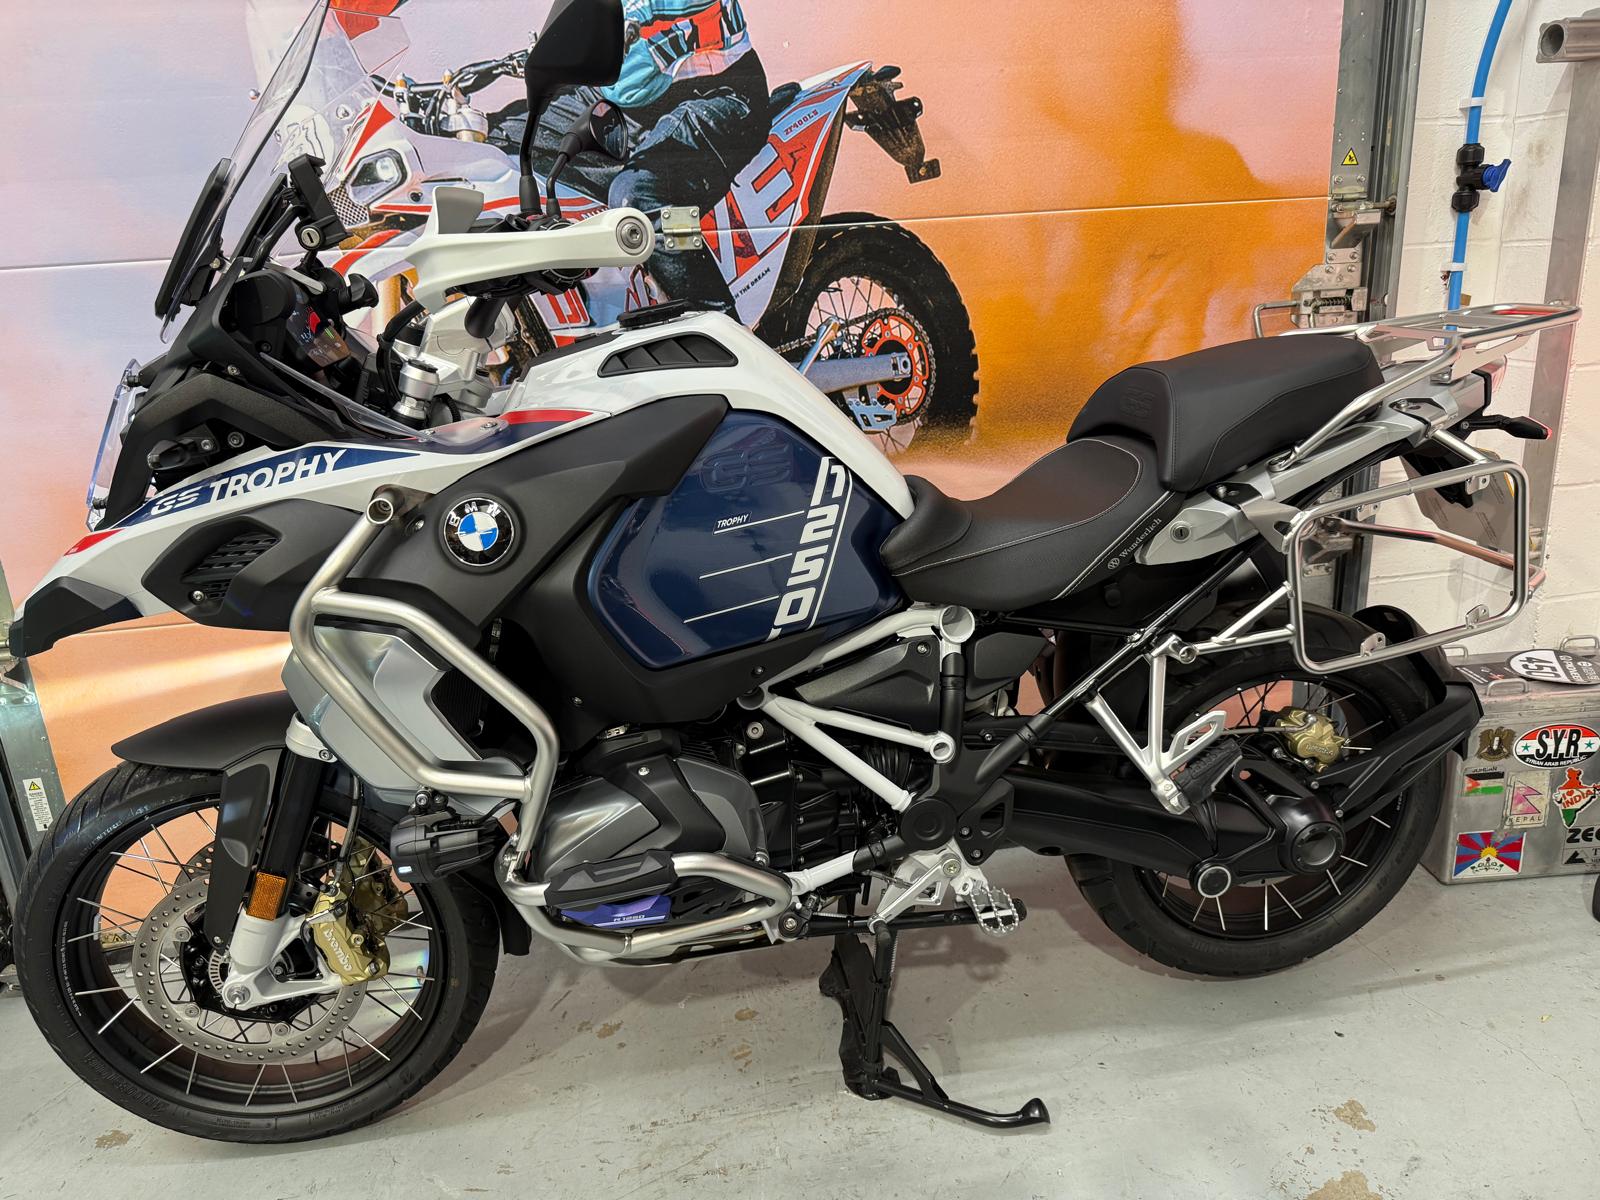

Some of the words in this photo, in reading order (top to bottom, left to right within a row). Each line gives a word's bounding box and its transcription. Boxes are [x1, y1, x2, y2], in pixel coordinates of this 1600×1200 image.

[739, 284, 750, 295] THE
[750, 267, 770, 287] DREAM
[208, 448, 348, 505] TROPHY
[448, 500, 502, 528] BMW
[716, 513, 750, 529] TROPHY
[773, 463, 847, 628] 1250
[1119, 518, 1162, 558] Wunderlich
[1519, 656, 1561, 679] 450
[1534, 728, 1582, 761] SYR
[1525, 756, 1544, 767] SYRIAN
[1562, 789, 1594, 809] INDIA
[324, 927, 353, 971] brembo
